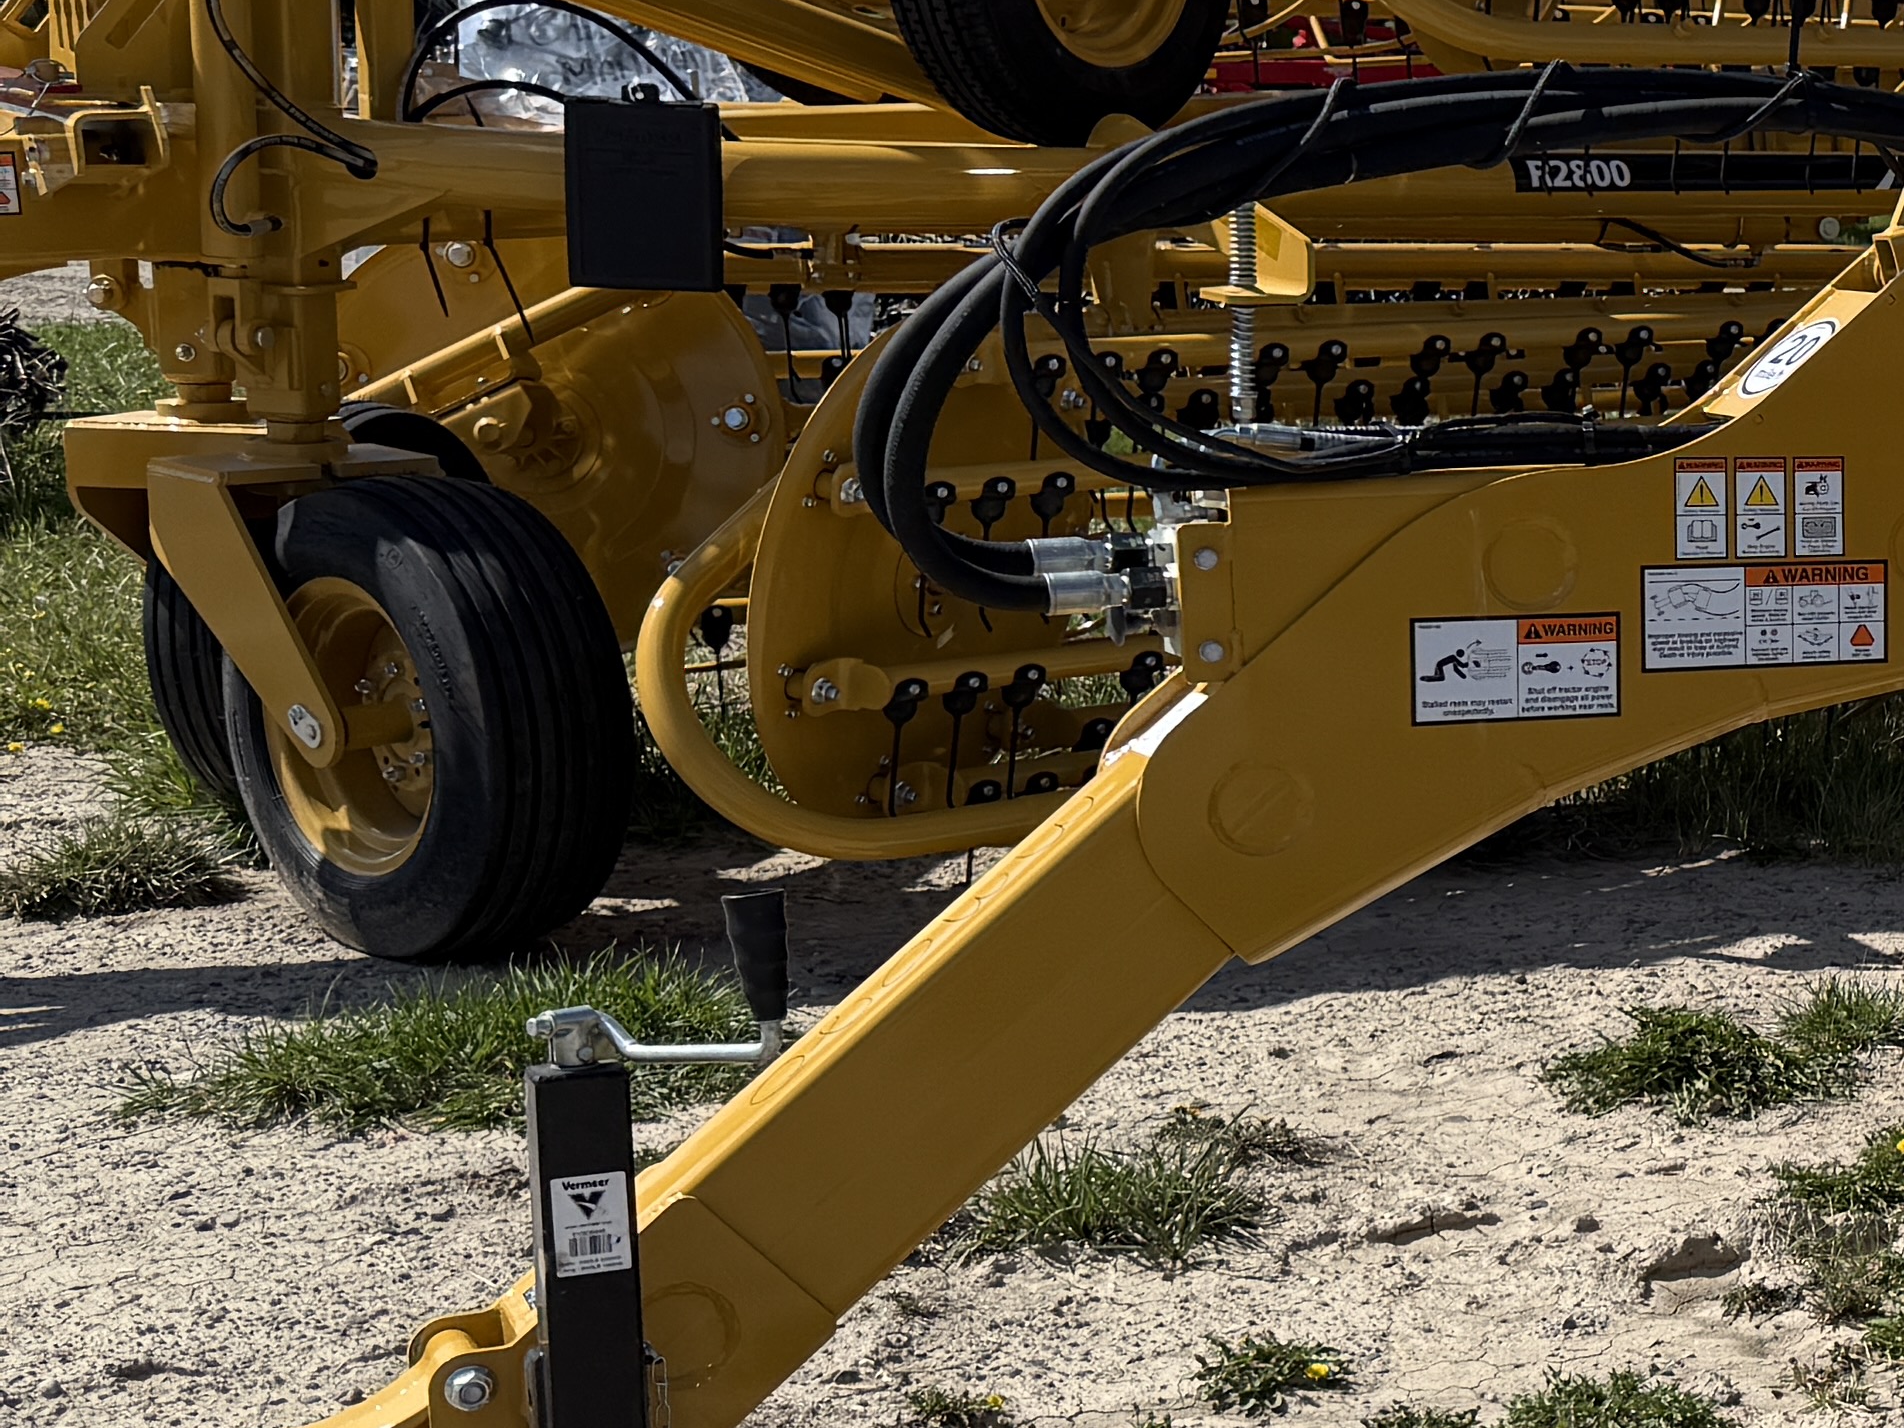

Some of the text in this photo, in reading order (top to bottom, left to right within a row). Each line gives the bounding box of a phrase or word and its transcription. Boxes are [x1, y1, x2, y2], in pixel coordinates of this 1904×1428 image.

[1525, 159, 1631, 188] R2800
[1768, 334, 1820, 366] 20
[1782, 566, 1870, 583] WARNING
[1541, 622, 1615, 637] WARNING
[562, 1178, 610, 1191] Vermeer
